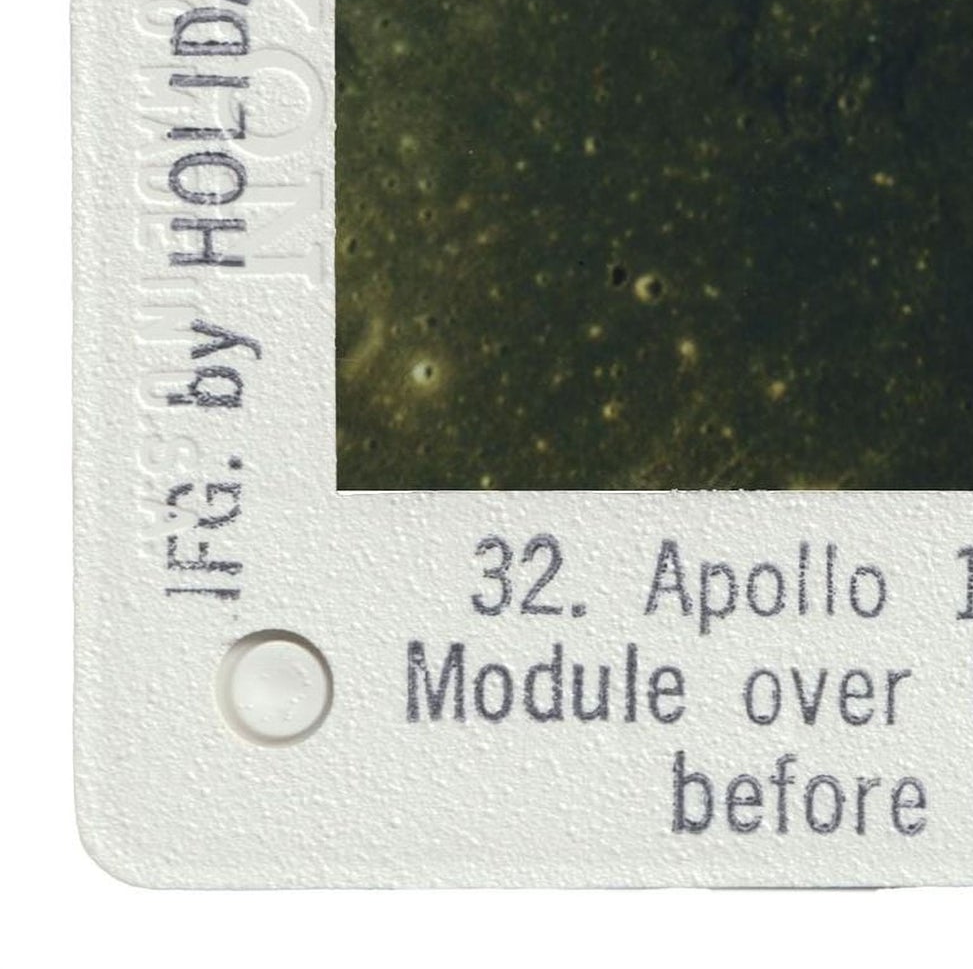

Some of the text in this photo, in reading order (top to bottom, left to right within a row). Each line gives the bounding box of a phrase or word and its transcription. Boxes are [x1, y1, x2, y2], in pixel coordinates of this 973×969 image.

[131, 62, 199, 253] MADE
[133, 275, 201, 347] IN
[164, 318, 263, 411] by
[469, 532, 588, 620] 32.
[642, 537, 888, 638] Apollo
[405, 638, 687, 726] Module
[741, 666, 913, 728] over
[670, 748, 929, 838] before
